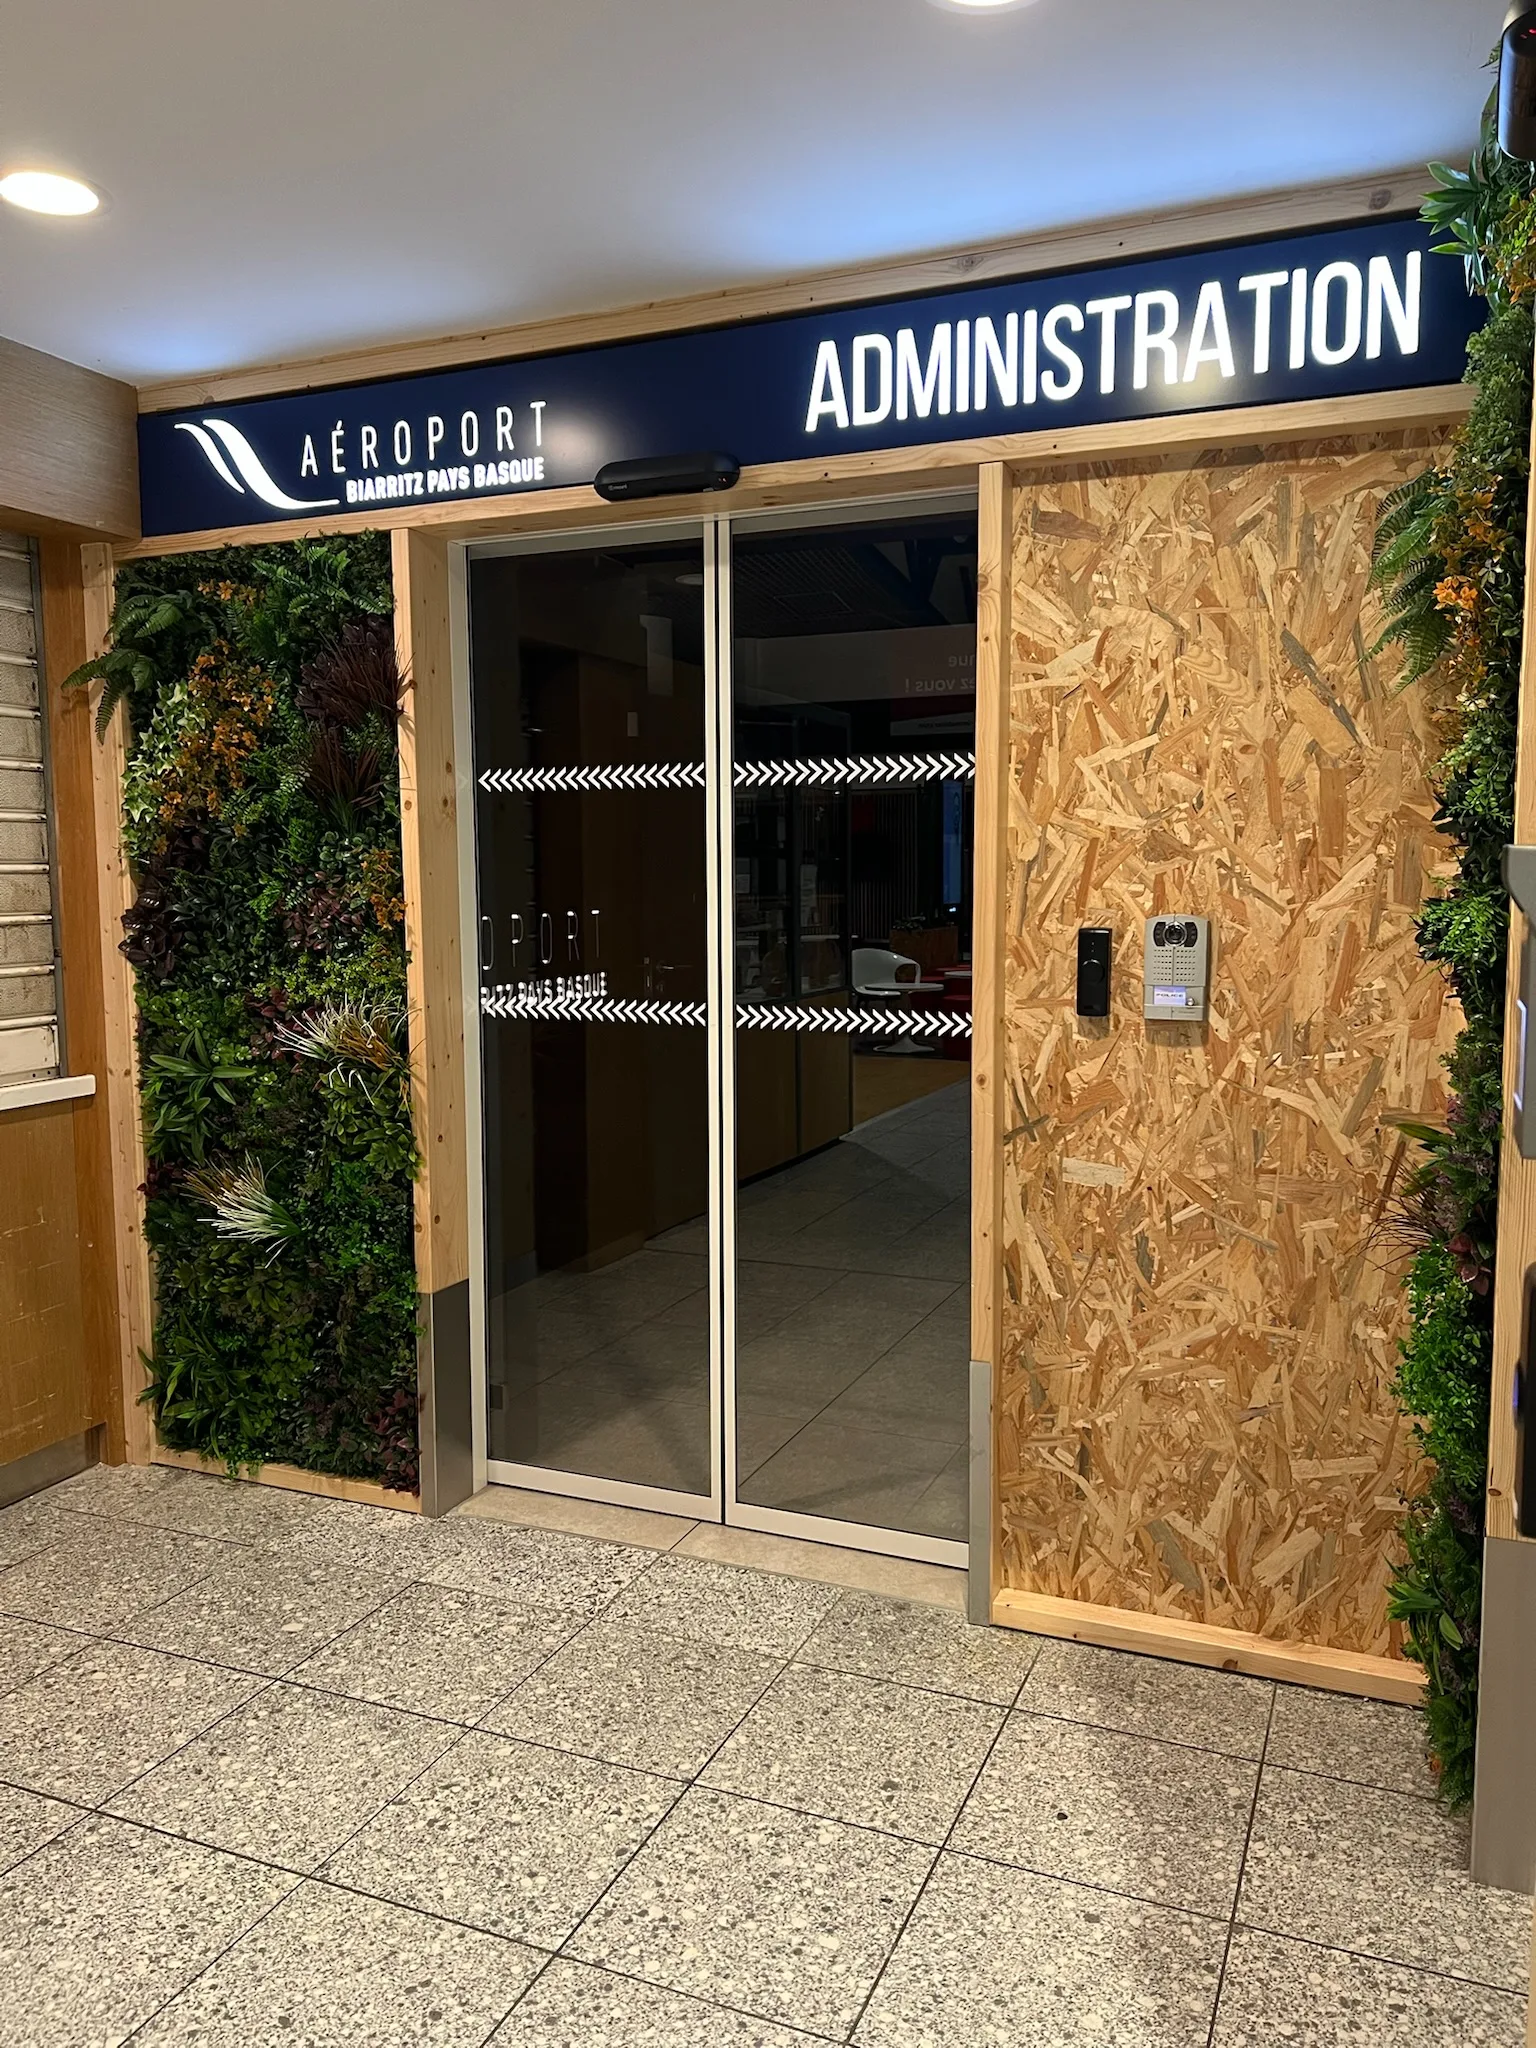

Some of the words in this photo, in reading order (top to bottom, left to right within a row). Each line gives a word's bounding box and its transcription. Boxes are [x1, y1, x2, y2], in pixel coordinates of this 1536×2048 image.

[804, 250, 1422, 433] ADMINISTRATION
[300, 400, 547, 478] AÉROPORT
[345, 471, 425, 504] BIARRITZ
[427, 465, 471, 494] PAYS
[473, 456, 545, 489] BASQUE
[556, 971, 608, 1003] BASQUE
